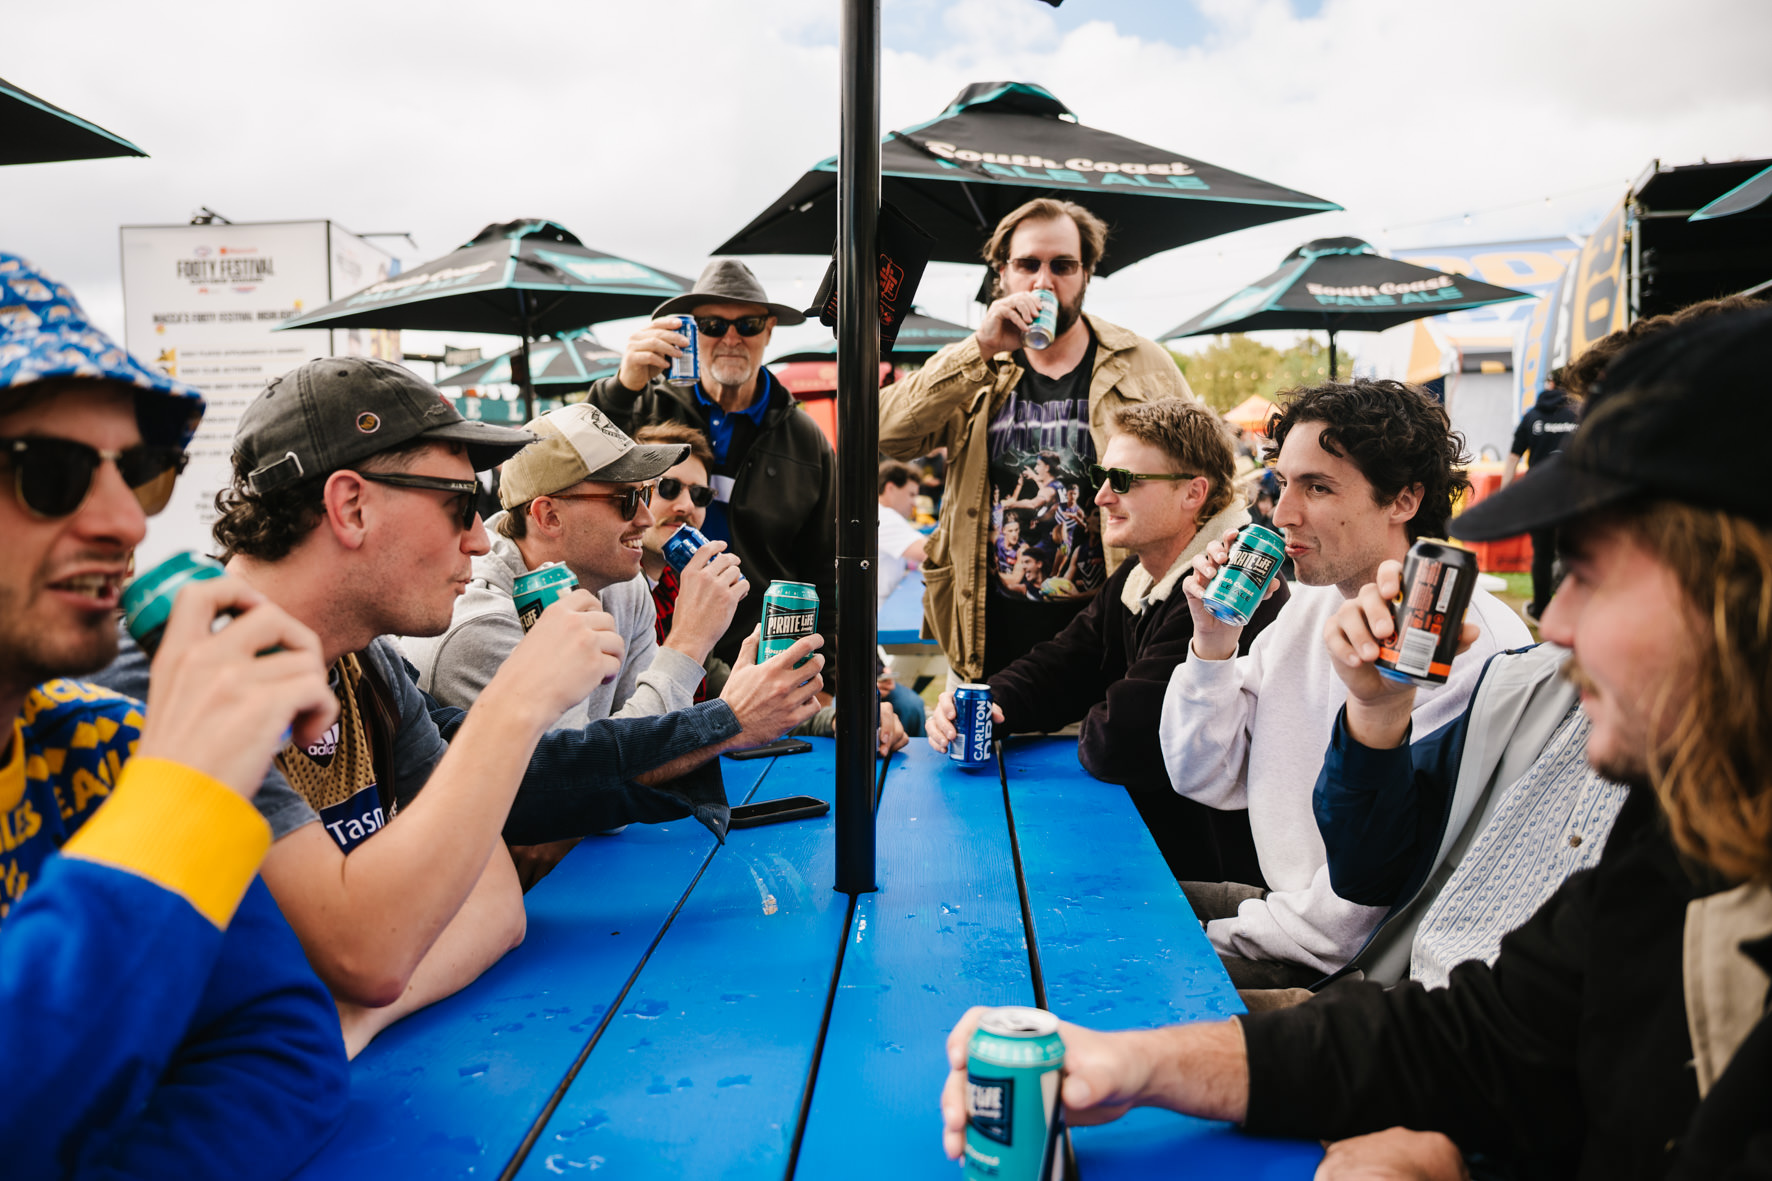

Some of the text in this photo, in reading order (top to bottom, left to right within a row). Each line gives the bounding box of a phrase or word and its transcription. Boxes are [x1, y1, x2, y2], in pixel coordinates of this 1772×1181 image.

[925, 141, 1195, 176] South Coast
[1101, 174, 1211, 190] ALE
[1306, 275, 1455, 296] South Coast
[1314, 286, 1464, 306] PALE ALE
[974, 700, 986, 761] CARLTON
[308, 744, 336, 756] adid
